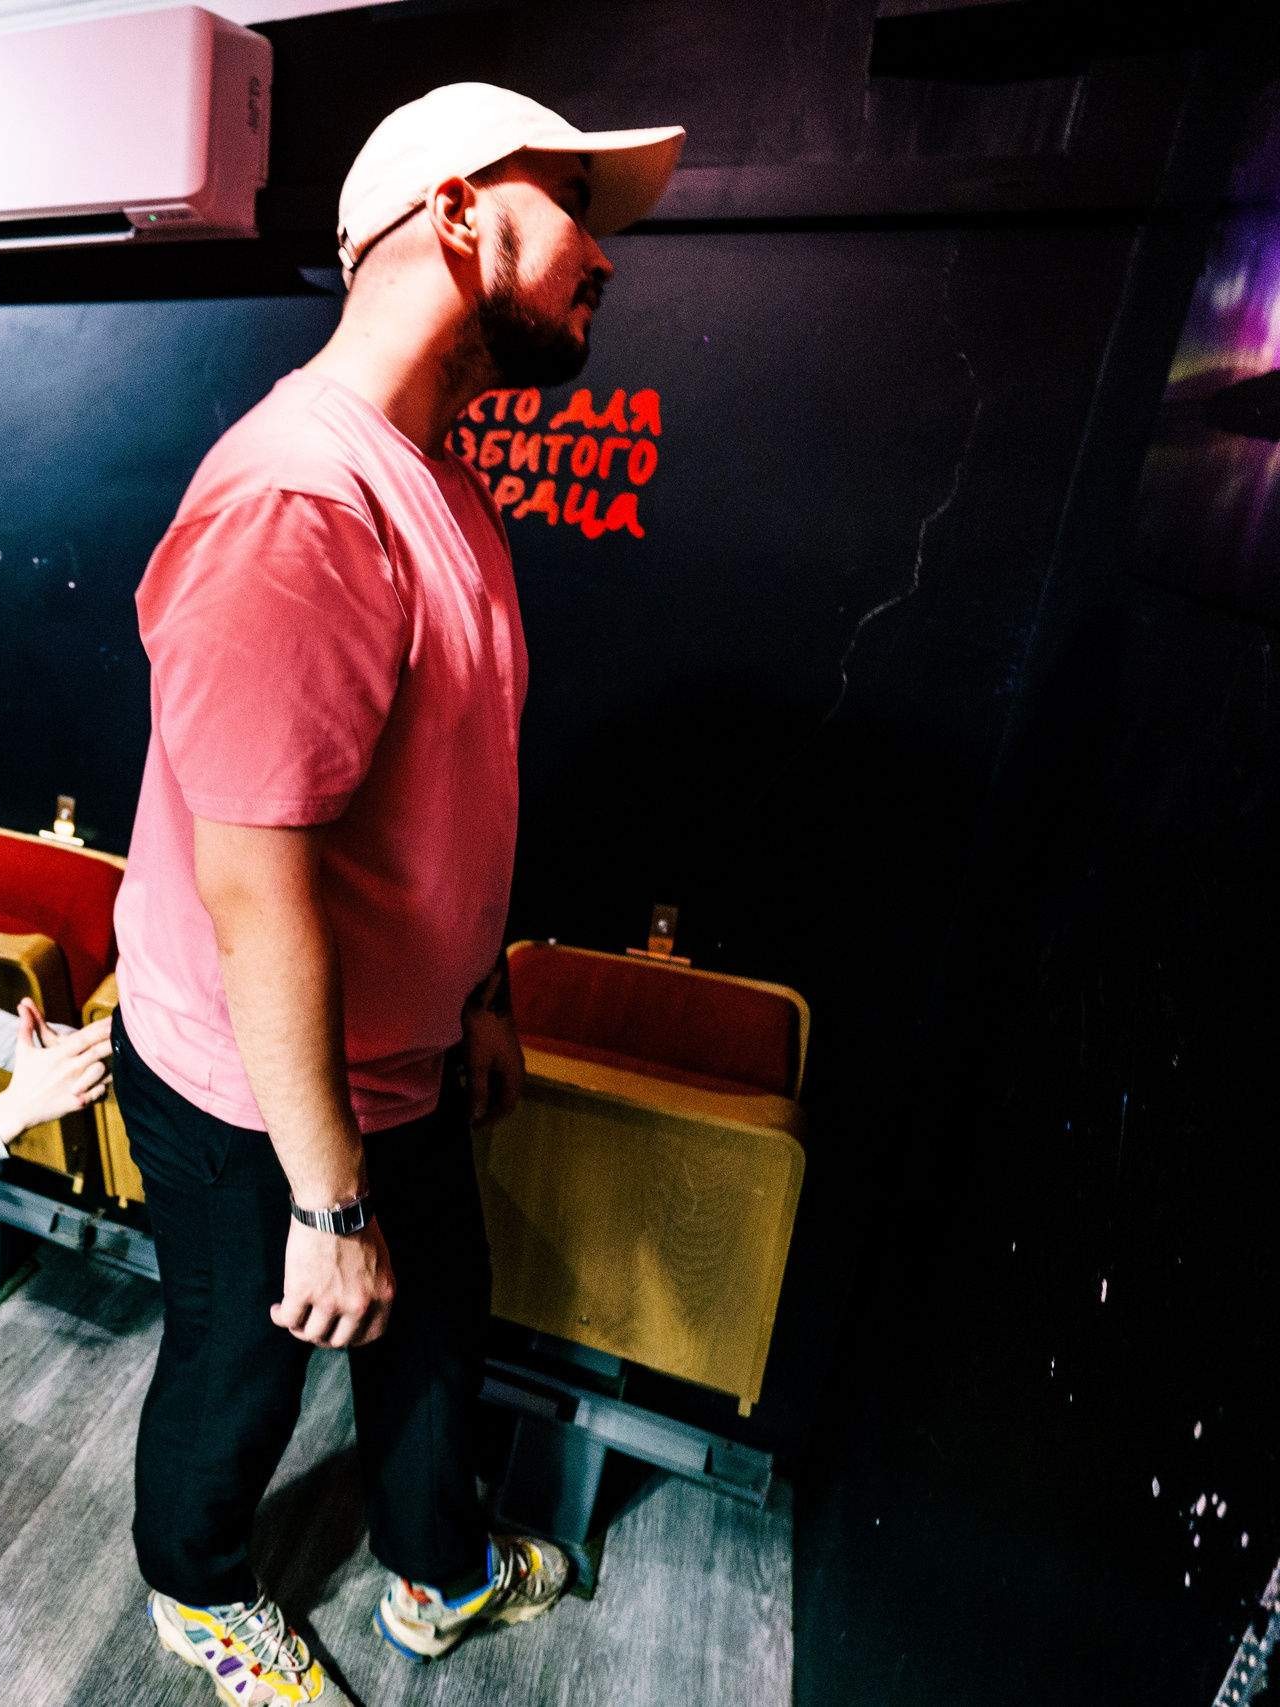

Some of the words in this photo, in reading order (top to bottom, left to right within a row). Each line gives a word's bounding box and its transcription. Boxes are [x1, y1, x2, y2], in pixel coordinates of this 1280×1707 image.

[457, 388, 541, 424] СТО
[549, 388, 661, 436] ДЛЯ
[444, 427, 658, 485] ЗБИТОГО
[480, 472, 645, 539] РДЦА
